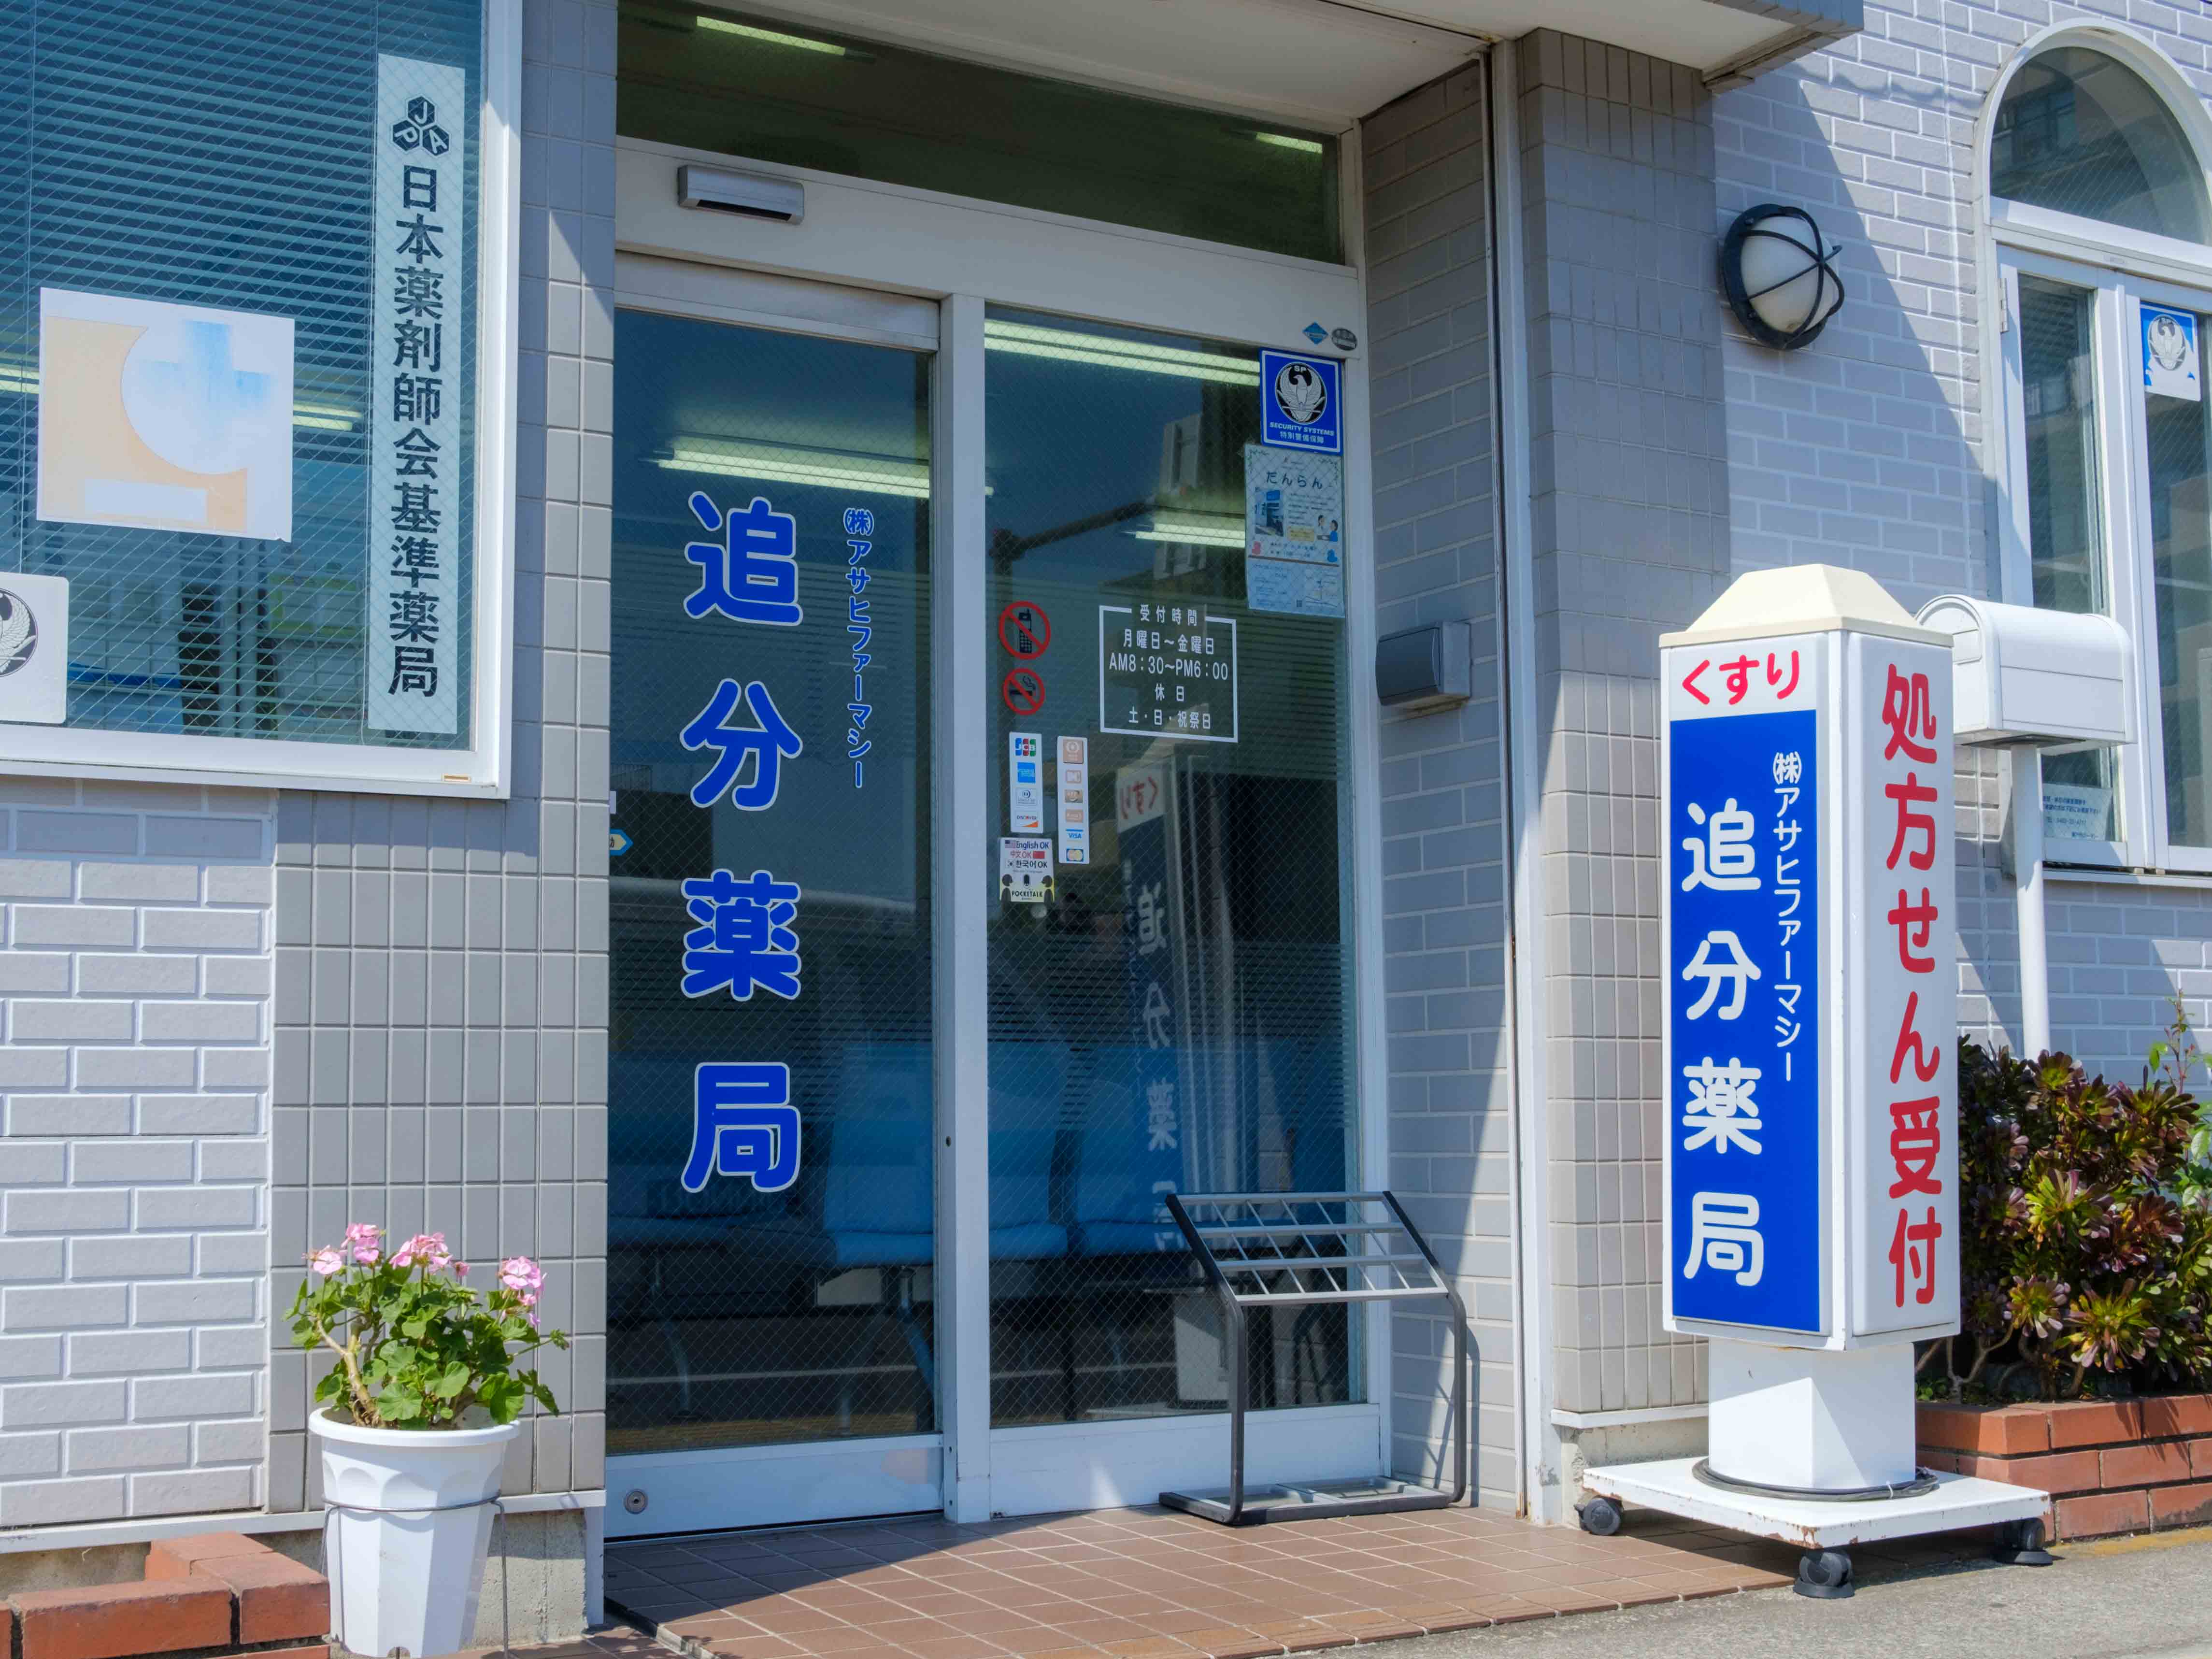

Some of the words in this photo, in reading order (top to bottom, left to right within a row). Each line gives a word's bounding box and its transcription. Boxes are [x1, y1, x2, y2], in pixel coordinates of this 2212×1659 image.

[388, 165, 444, 699] 日本薬剤師会基準薬局
[1270, 422, 1301, 431] SECURITY
[1304, 427, 1334, 436] SYSTEMS
[1140, 604, 1198, 627] 受付時間
[1682, 650, 1799, 706] くすり
[680, 491, 803, 1192] 追分薬局
[1016, 841, 1039, 850] English
[1682, 798, 1764, 1287] 追分薬局
[1882, 664, 1942, 1308] 処方せん受付
